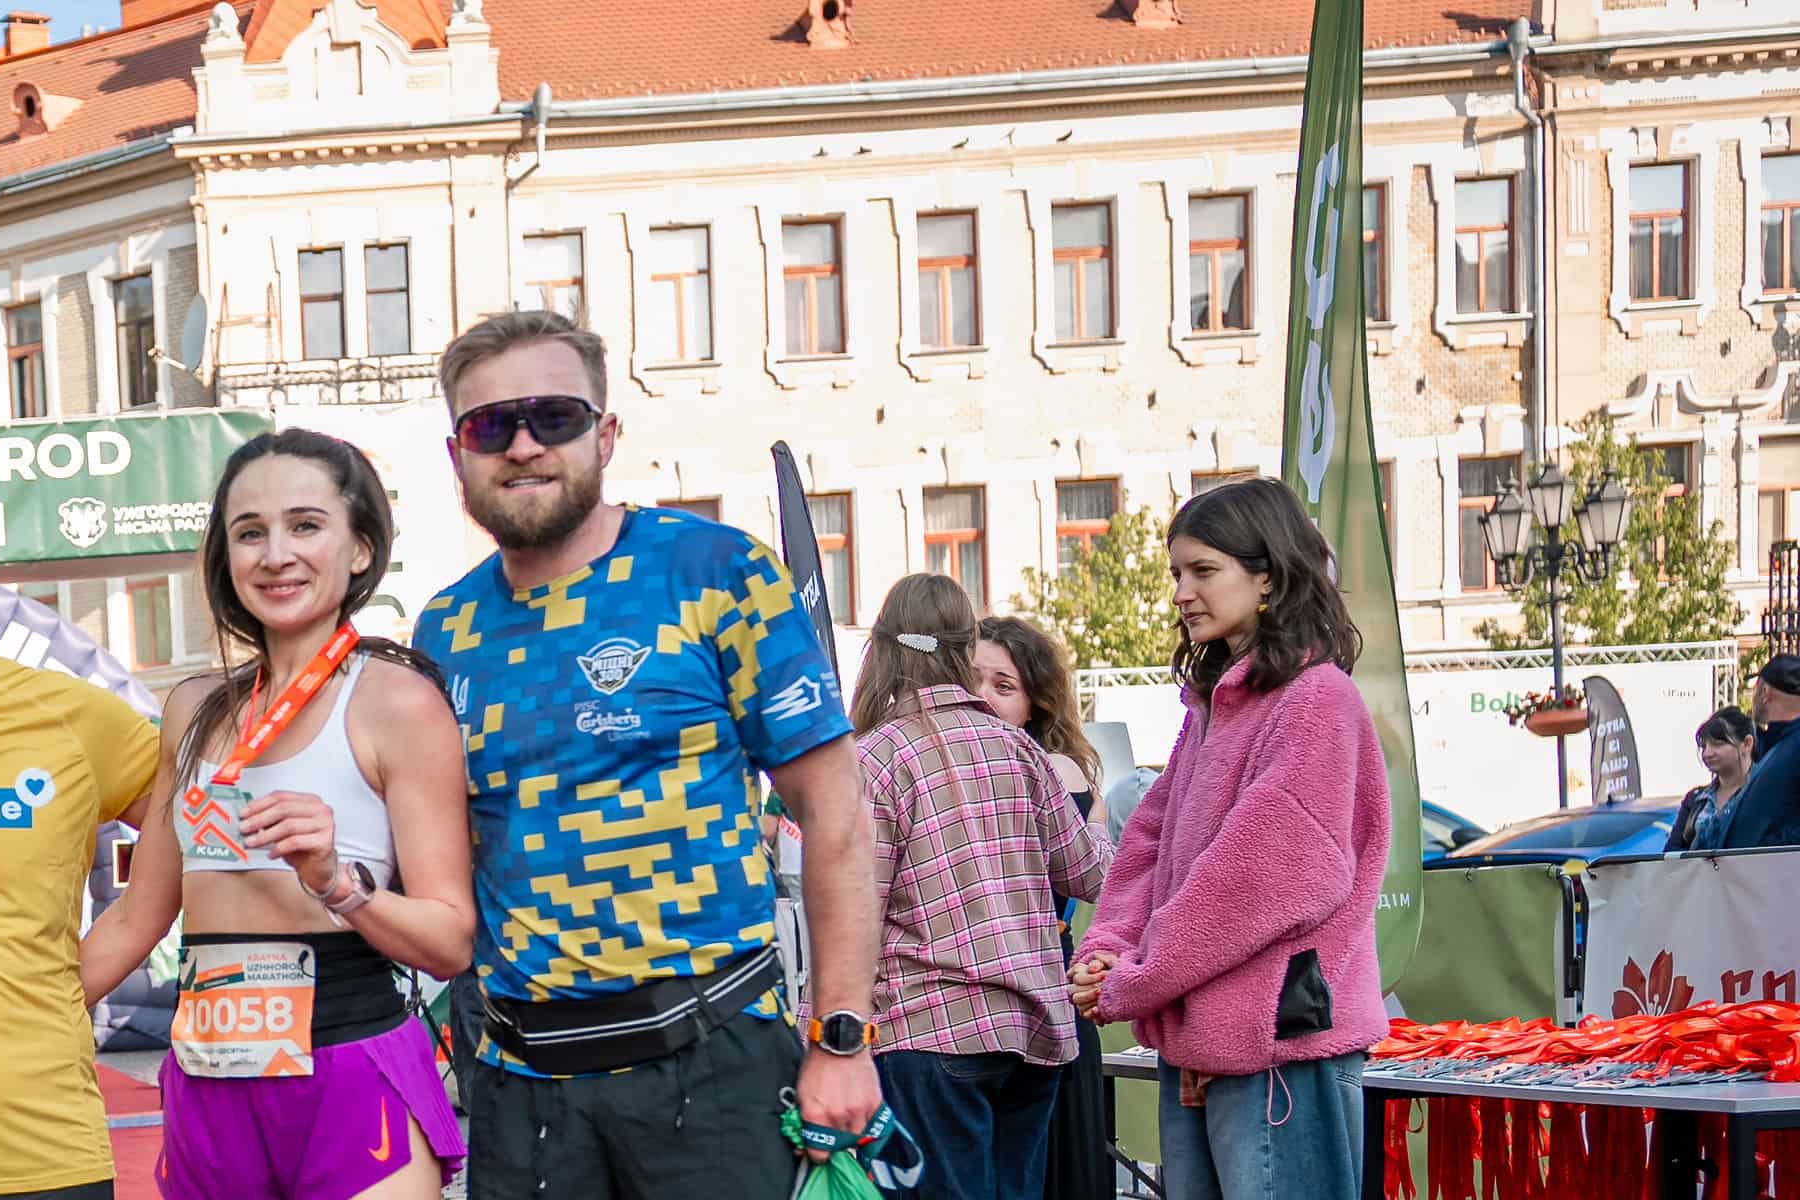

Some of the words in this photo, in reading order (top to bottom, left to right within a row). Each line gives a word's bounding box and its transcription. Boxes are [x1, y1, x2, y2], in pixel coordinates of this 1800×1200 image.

[175, 517, 208, 532] РАД
[576, 708, 642, 735] Carlsberg
[184, 996, 294, 1034] 10058
